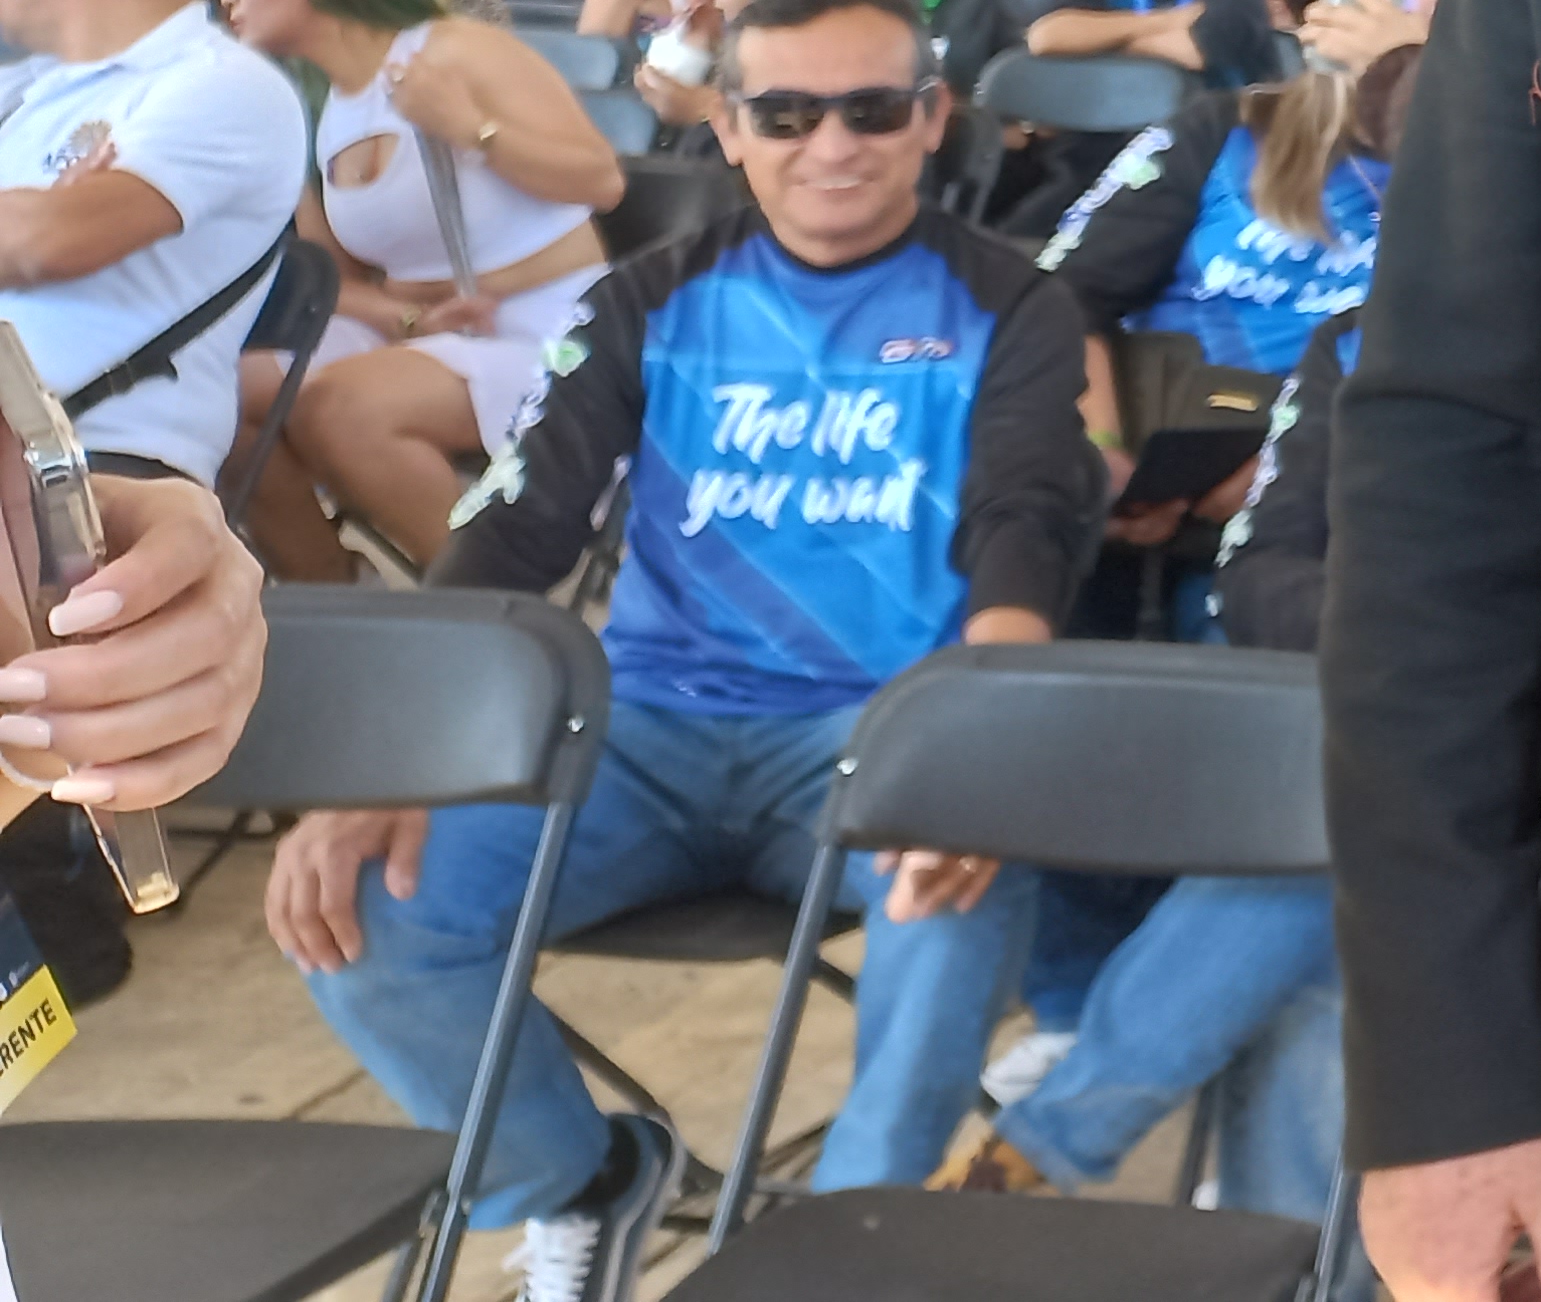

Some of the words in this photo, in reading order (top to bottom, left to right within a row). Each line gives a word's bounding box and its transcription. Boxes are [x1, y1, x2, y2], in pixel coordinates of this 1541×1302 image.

[712, 382, 811, 464] The
[811, 386, 898, 465] life
[678, 468, 795, 538] you
[802, 458, 925, 532] want
